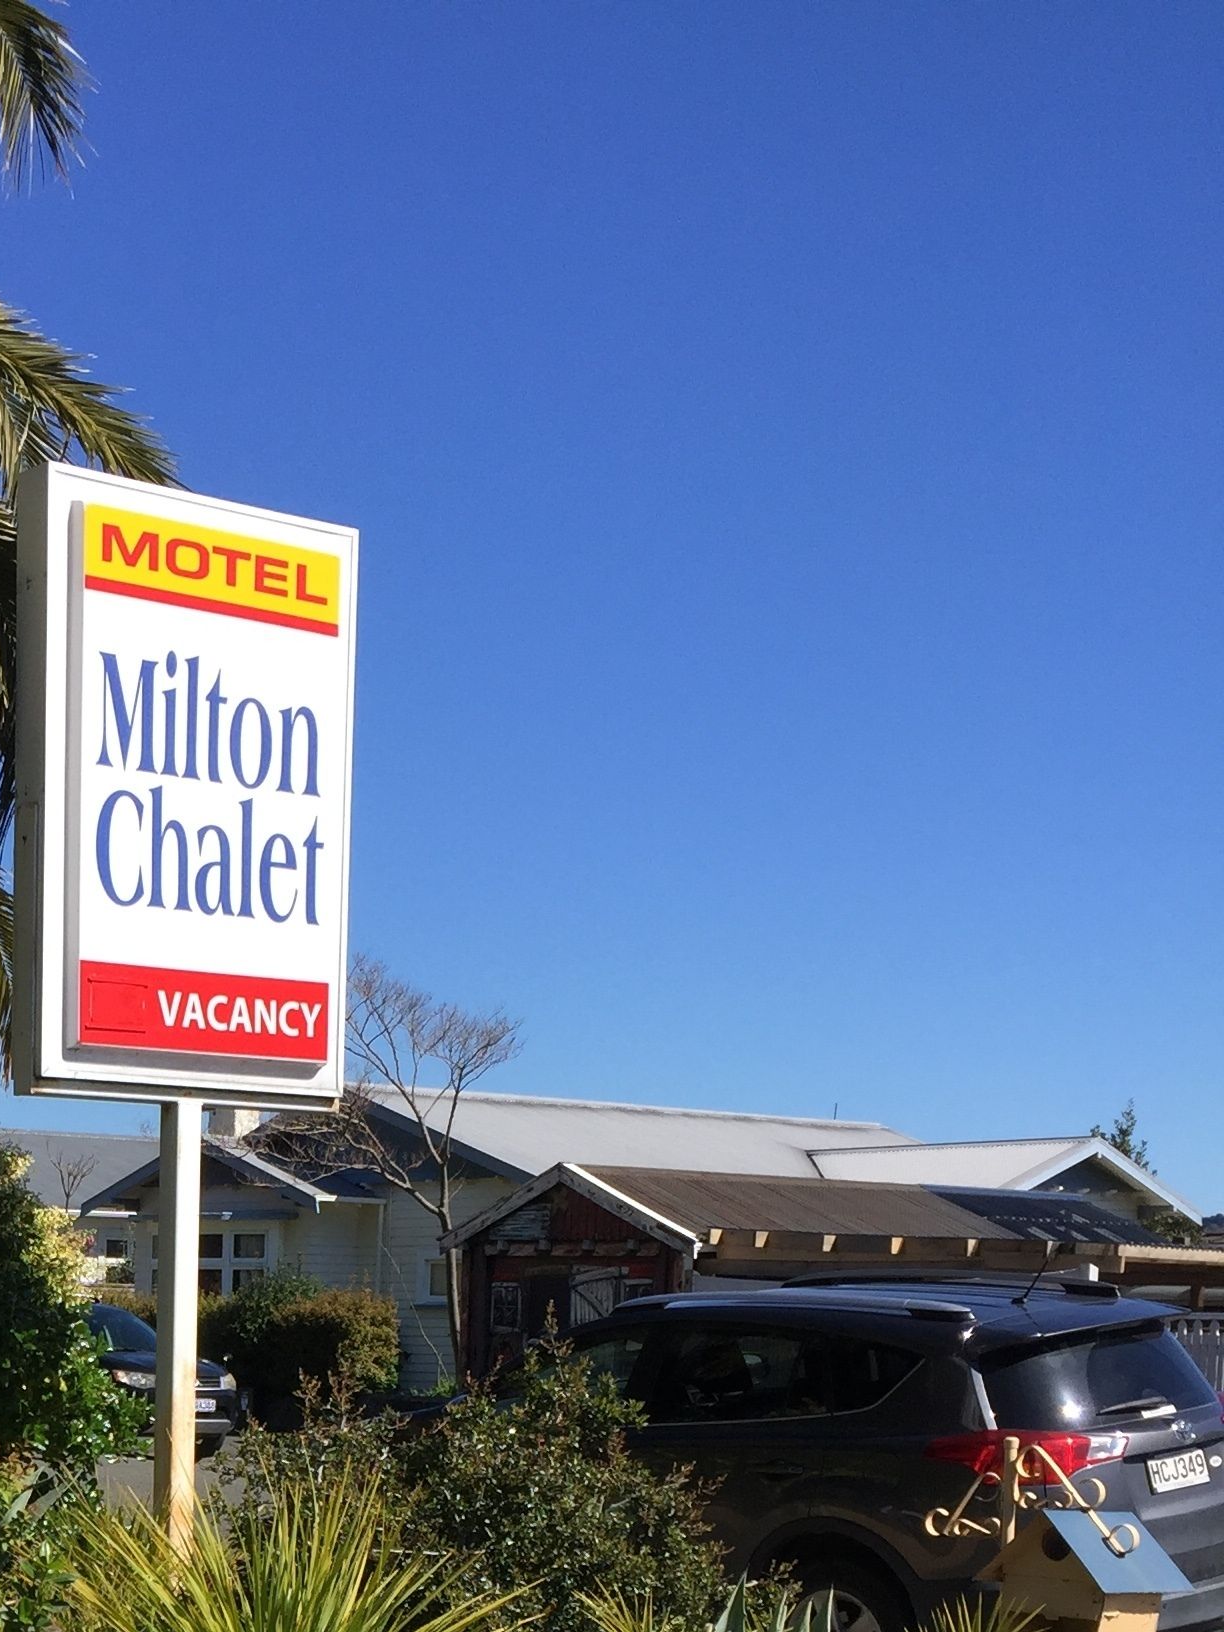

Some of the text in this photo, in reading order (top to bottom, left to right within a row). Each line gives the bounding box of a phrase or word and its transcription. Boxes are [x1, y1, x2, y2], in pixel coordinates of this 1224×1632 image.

[102, 523, 328, 606] MOTEL
[96, 649, 322, 798] Milton
[95, 786, 325, 926] Chalet
[157, 989, 322, 1038] VACANCY
[1150, 1453, 1205, 1484] HCJ349
